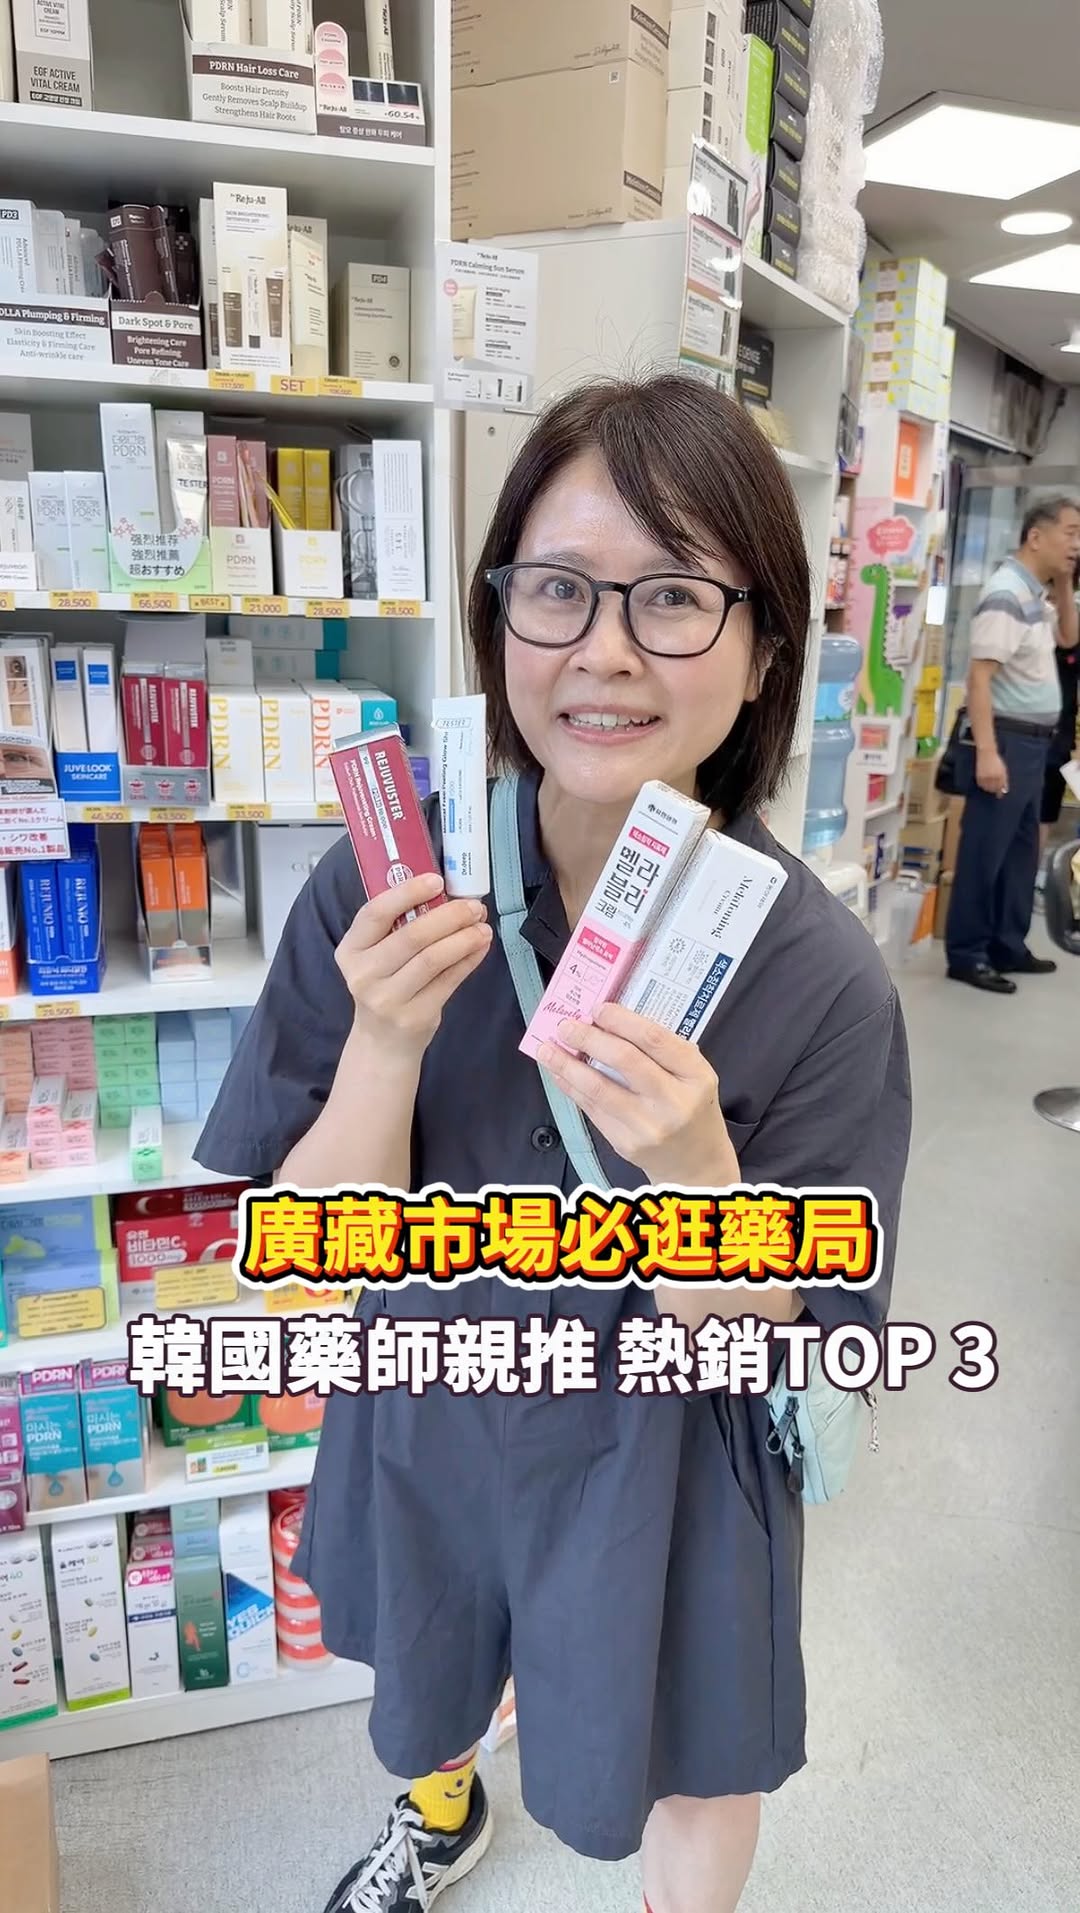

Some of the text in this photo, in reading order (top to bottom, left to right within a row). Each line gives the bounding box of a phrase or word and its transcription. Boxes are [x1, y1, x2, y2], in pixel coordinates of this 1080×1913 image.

[33, 66, 76, 81] EGF ACTIVE
[209, 60, 299, 80] PDRN Hair Loss Care
[30, 77, 80, 93] VITAL CREAM
[220, 82, 289, 99] Boosts Hair Density
[202, 92, 308, 112] Gently Removes Scalp Buildup
[214, 106, 296, 122] Strengthens Hair Roots
[1, 210, 18, 220] PD3
[22, 309, 63, 323] Plumping
[64, 313, 70, 321] &
[71, 313, 106, 326] Firming
[118, 316, 195, 330] Dark Spot & Pore
[14, 328, 87, 340] Skin Boosting Effect
[6, 336, 41, 348] Elasticity
[48, 340, 78, 351] Firming
[78, 343, 96, 351] Care
[127, 335, 188, 348] Brightening Care
[19, 349, 85, 361] Anti-wrinkle care
[134, 346, 182, 358] Pore Refining
[127, 356, 190, 368] Uneven Tone Care
[280, 378, 306, 392] SET
[177, 478, 208, 489] TESTER
[226, 555, 257, 565] PDRN
[129, 564, 186, 577] 超おすすめ
[58, 599, 92, 608] 28,500
[138, 600, 172, 609] 66,500
[249, 604, 282, 613] 21,000
[312, 607, 343, 616] 28,500
[385, 606, 415, 616] 28,500
[212, 698, 231, 770] PDRN
[263, 699, 281, 770] PDRN
[313, 699, 330, 769] PDRN
[71, 772, 108, 781] SKINCARE
[375, 750, 404, 821] REJUVUSTER
[354, 775, 370, 817] Rejuvenating
[620, 845, 659, 887] 멜라
[603, 871, 648, 914] 블리
[594, 900, 617, 920] 크림
[32, 1367, 73, 1383] PDRN
[92, 1364, 128, 1380] PDRN
[86, 1421, 122, 1434] PDRN
[26, 1430, 62, 1443] PDRN
